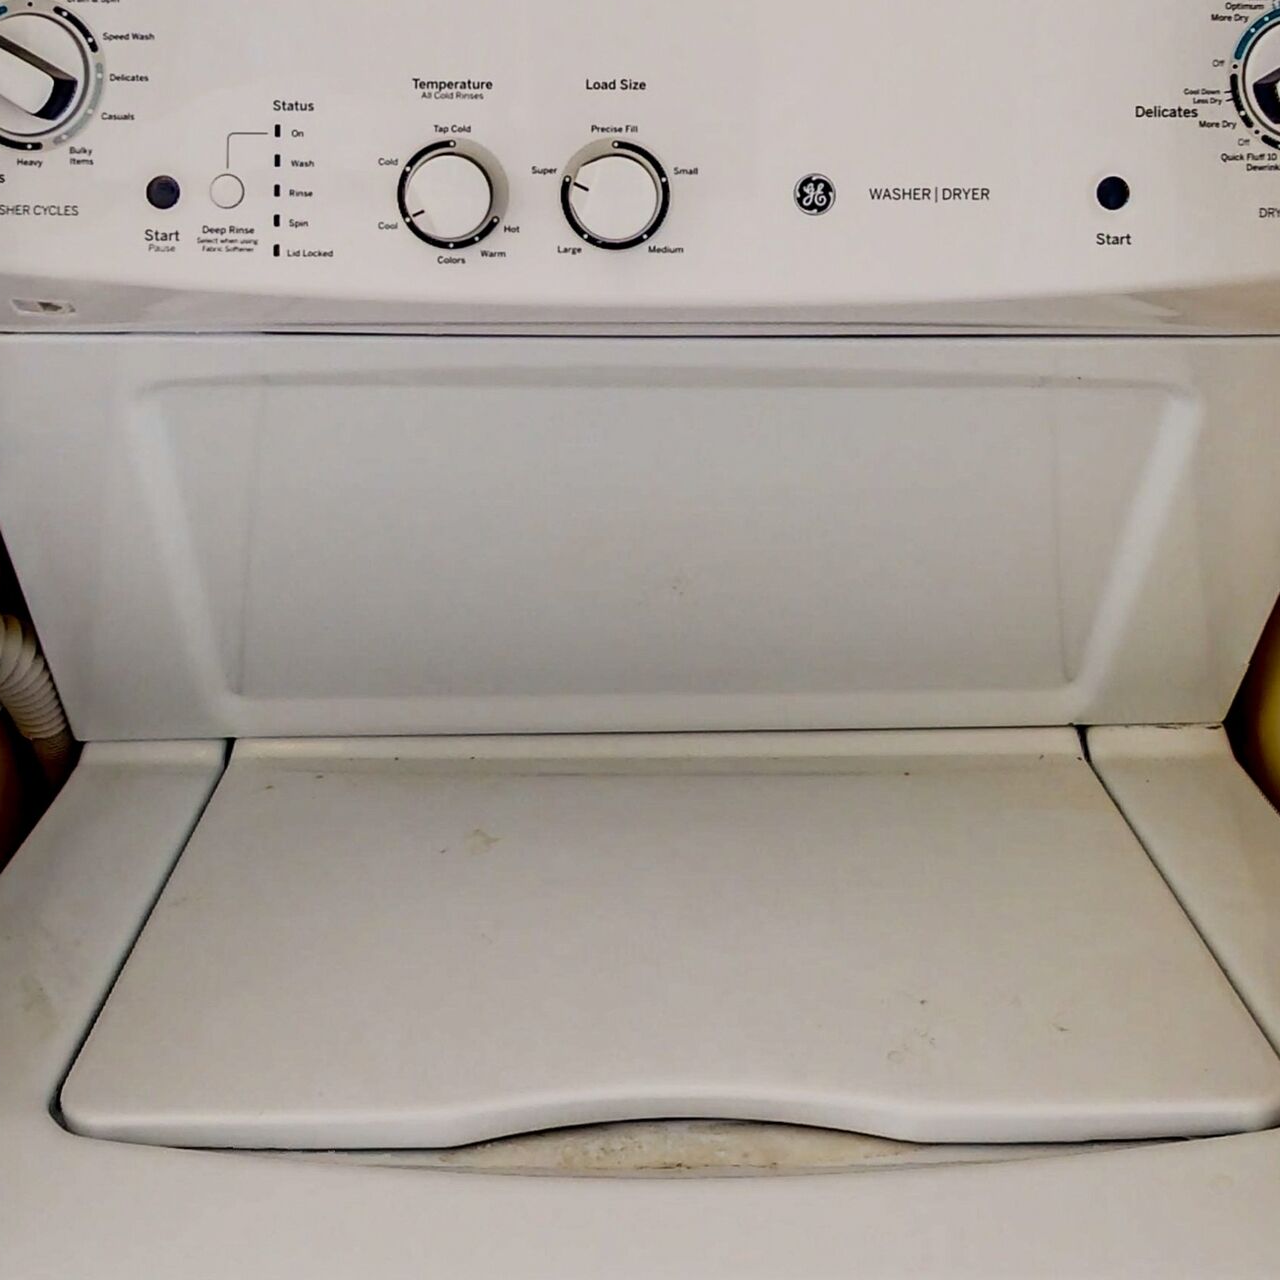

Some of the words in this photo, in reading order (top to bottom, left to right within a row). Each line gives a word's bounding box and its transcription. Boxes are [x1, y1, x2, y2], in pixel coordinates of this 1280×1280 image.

[1225, 2, 1264, 11] Optimum
[1233, 14, 1249, 23] Dry
[103, 33, 129, 42] Speed
[110, 74, 149, 82] Delicates
[412, 78, 493, 91] Temperature
[586, 79, 616, 90] Load
[620, 79, 646, 90] Size
[456, 92, 484, 100] Rinses
[273, 100, 314, 111] Status
[1135, 106, 1198, 118] Delicates
[434, 125, 449, 133] Tap
[451, 125, 471, 133] Cold
[591, 125, 623, 133] Precise
[625, 125, 638, 133] Fill
[1221, 121, 1236, 130] Dry
[1237, 138, 1250, 146] Off
[70, 147, 93, 156] Bulky
[378, 158, 398, 166] Cold
[1221, 154, 1244, 162] Quick
[1247, 153, 1265, 161] Fluff
[17, 159, 43, 167] Heavy
[532, 166, 557, 175] Super
[673, 167, 698, 175] Small
[289, 189, 313, 197] Rinse
[869, 188, 931, 201] WASHER
[942, 188, 990, 201] DRYER
[33, 206, 79, 216] CYCLES
[289, 220, 308, 228] Spin
[378, 222, 398, 230] Cool
[144, 229, 180, 241] Start
[202, 226, 226, 235] Deep
[229, 226, 254, 234] Rinse
[1096, 233, 1132, 246] Start
[148, 244, 176, 252] Pause
[557, 246, 582, 255] Large
[648, 246, 684, 254] Medium
[287, 249, 301, 257] Lid
[303, 249, 333, 257] Locked
[437, 256, 465, 264] Colors
